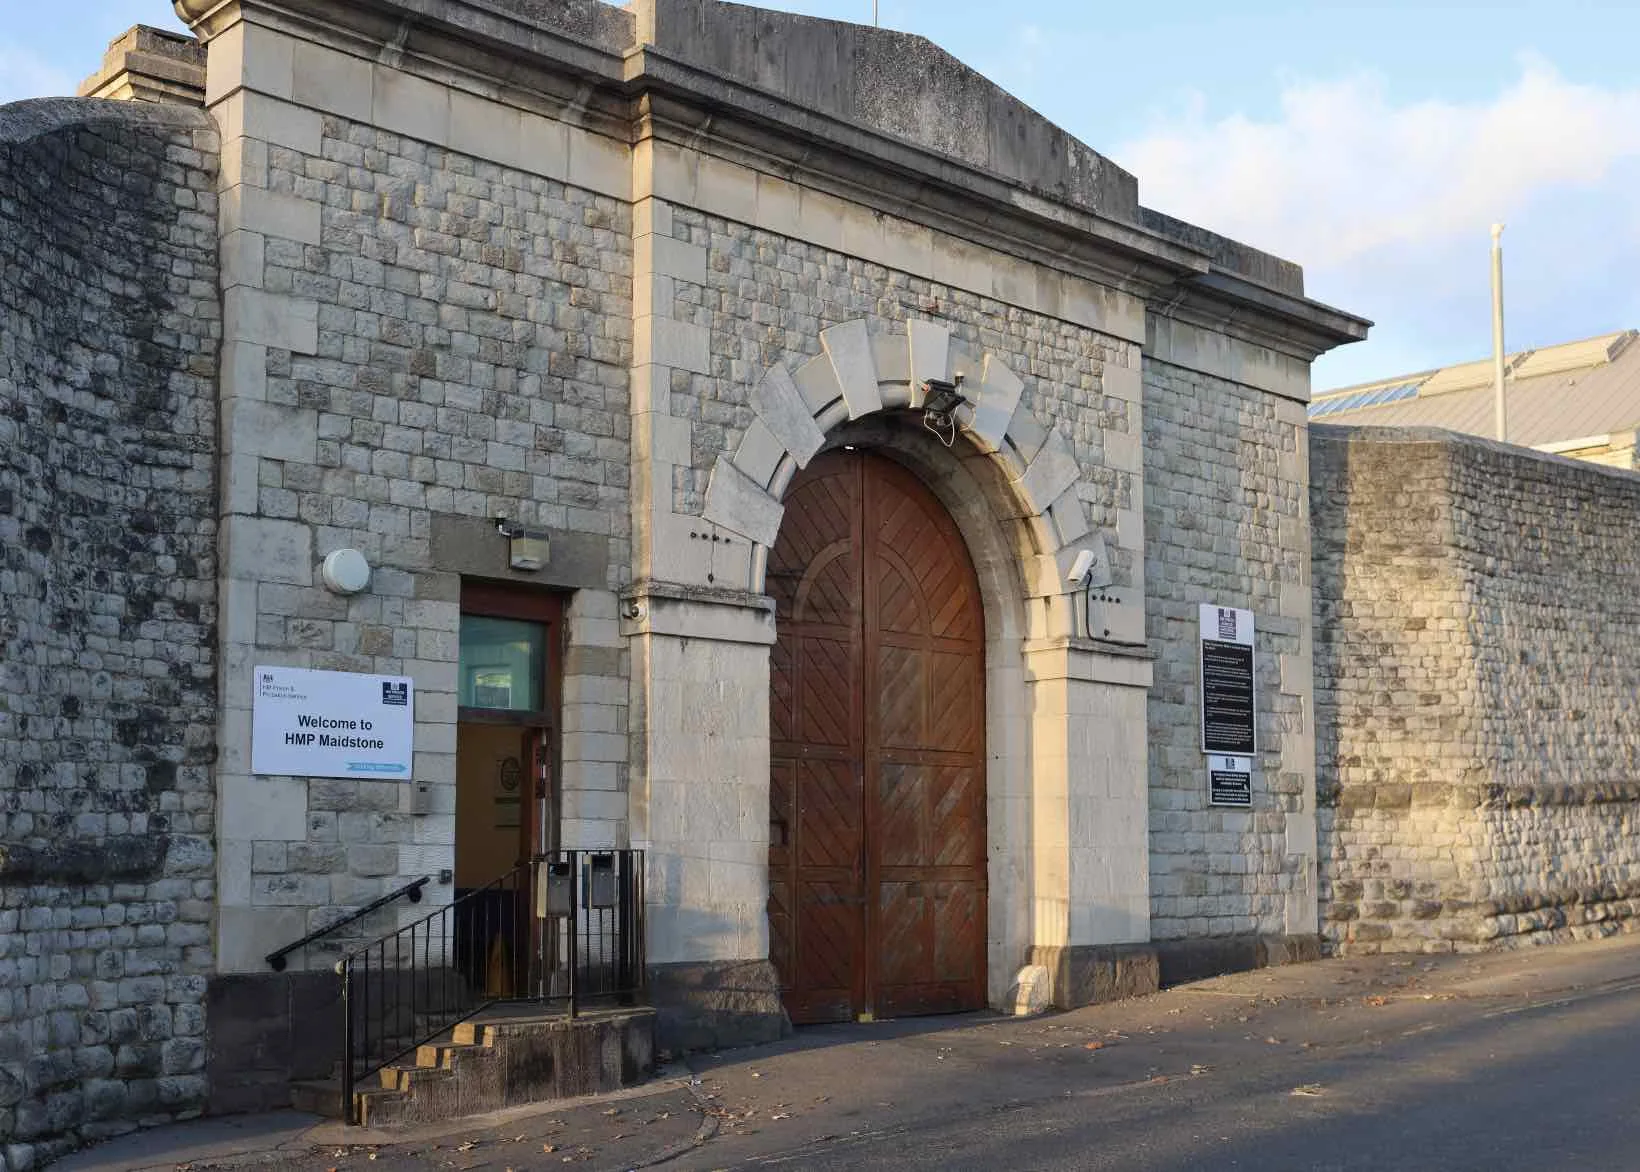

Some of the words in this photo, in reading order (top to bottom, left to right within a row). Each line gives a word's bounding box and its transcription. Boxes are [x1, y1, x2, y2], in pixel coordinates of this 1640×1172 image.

[298, 714, 356, 729] Welcome
[360, 719, 373, 730] to
[285, 732, 316, 745] HMP
[319, 734, 384, 749] Maidstone
